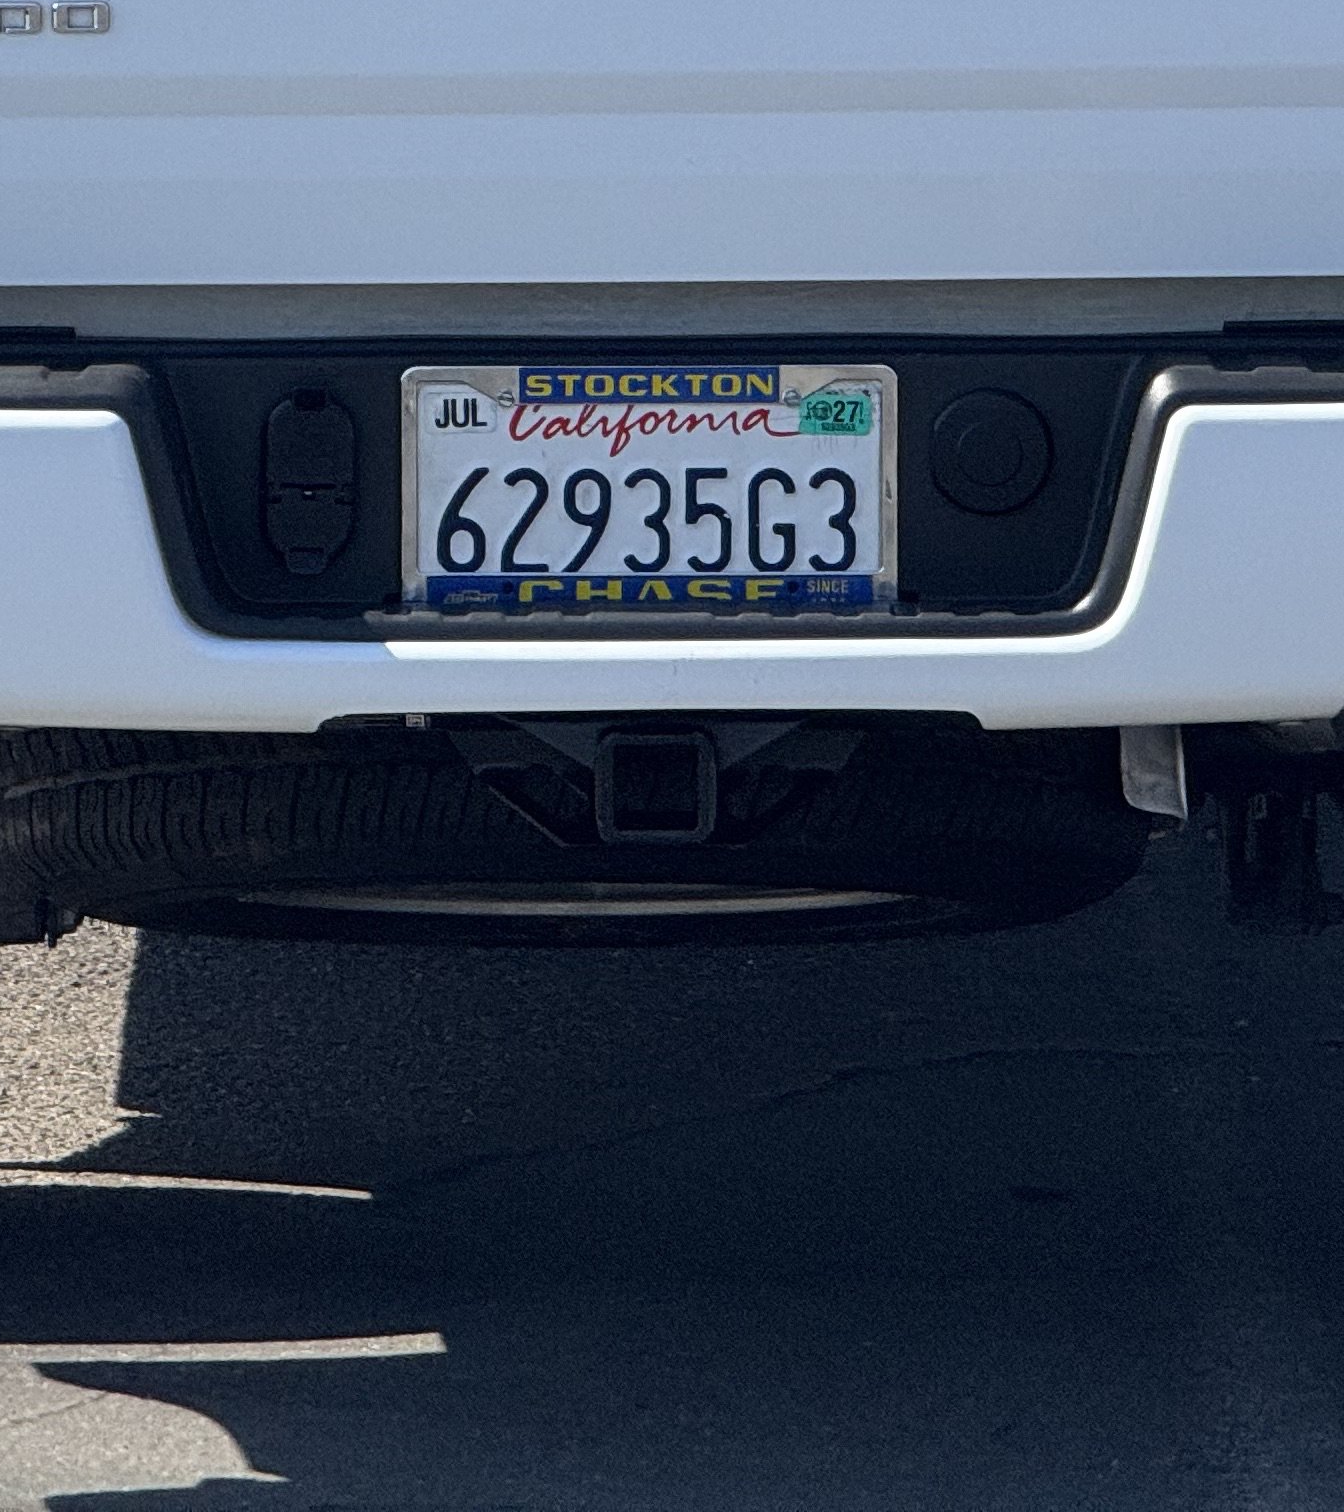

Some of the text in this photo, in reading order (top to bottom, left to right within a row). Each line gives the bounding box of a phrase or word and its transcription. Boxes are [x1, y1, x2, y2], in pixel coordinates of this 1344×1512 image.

[525, 373, 773, 397] STOCKTON
[434, 398, 487, 429] JUL
[833, 399, 860, 423] 27
[509, 402, 801, 456] California
[436, 466, 856, 573] 62935G3
[806, 578, 849, 594] SINCE
